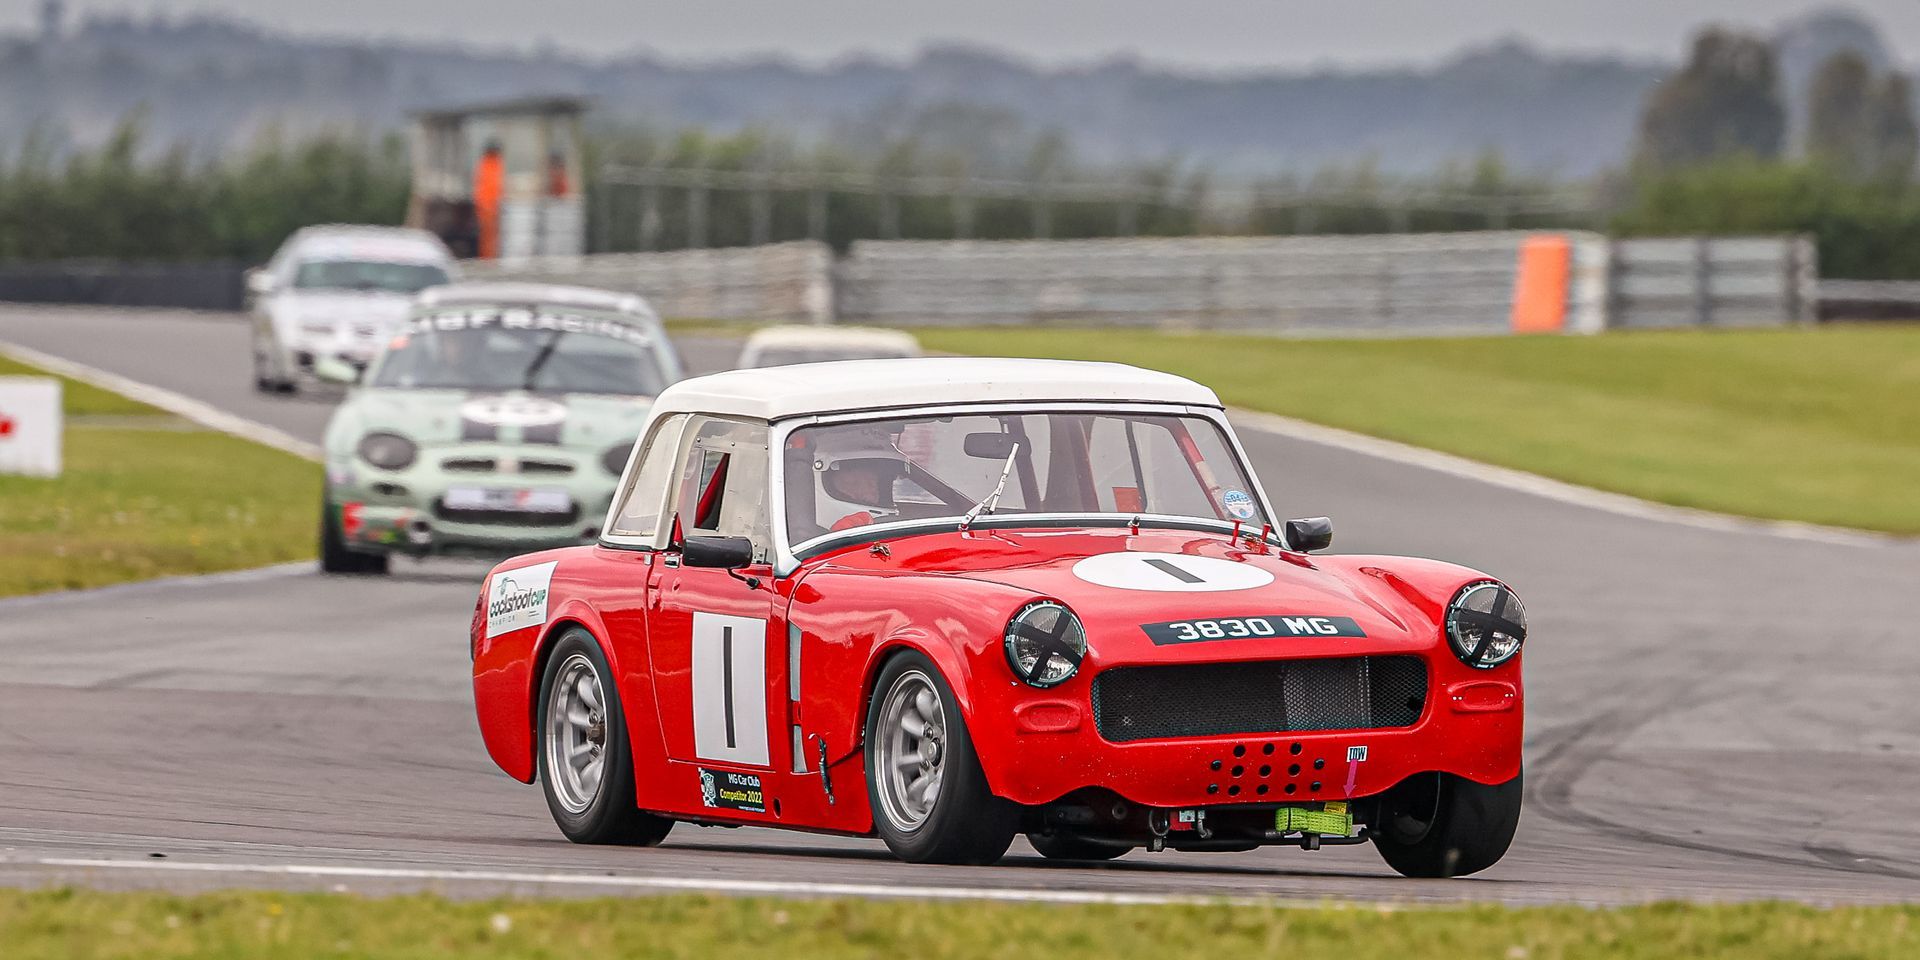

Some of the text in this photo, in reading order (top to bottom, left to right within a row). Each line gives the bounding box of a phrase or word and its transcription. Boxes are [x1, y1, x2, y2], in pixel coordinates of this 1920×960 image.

[1142, 559, 1207, 583] 1
[1169, 616, 1339, 641] 3830 MG
[723, 626, 736, 748] 1
[1349, 747, 1366, 760] TOW
[728, 773, 760, 787] MG Car Club
[720, 788, 763, 804] Competitor 2022
